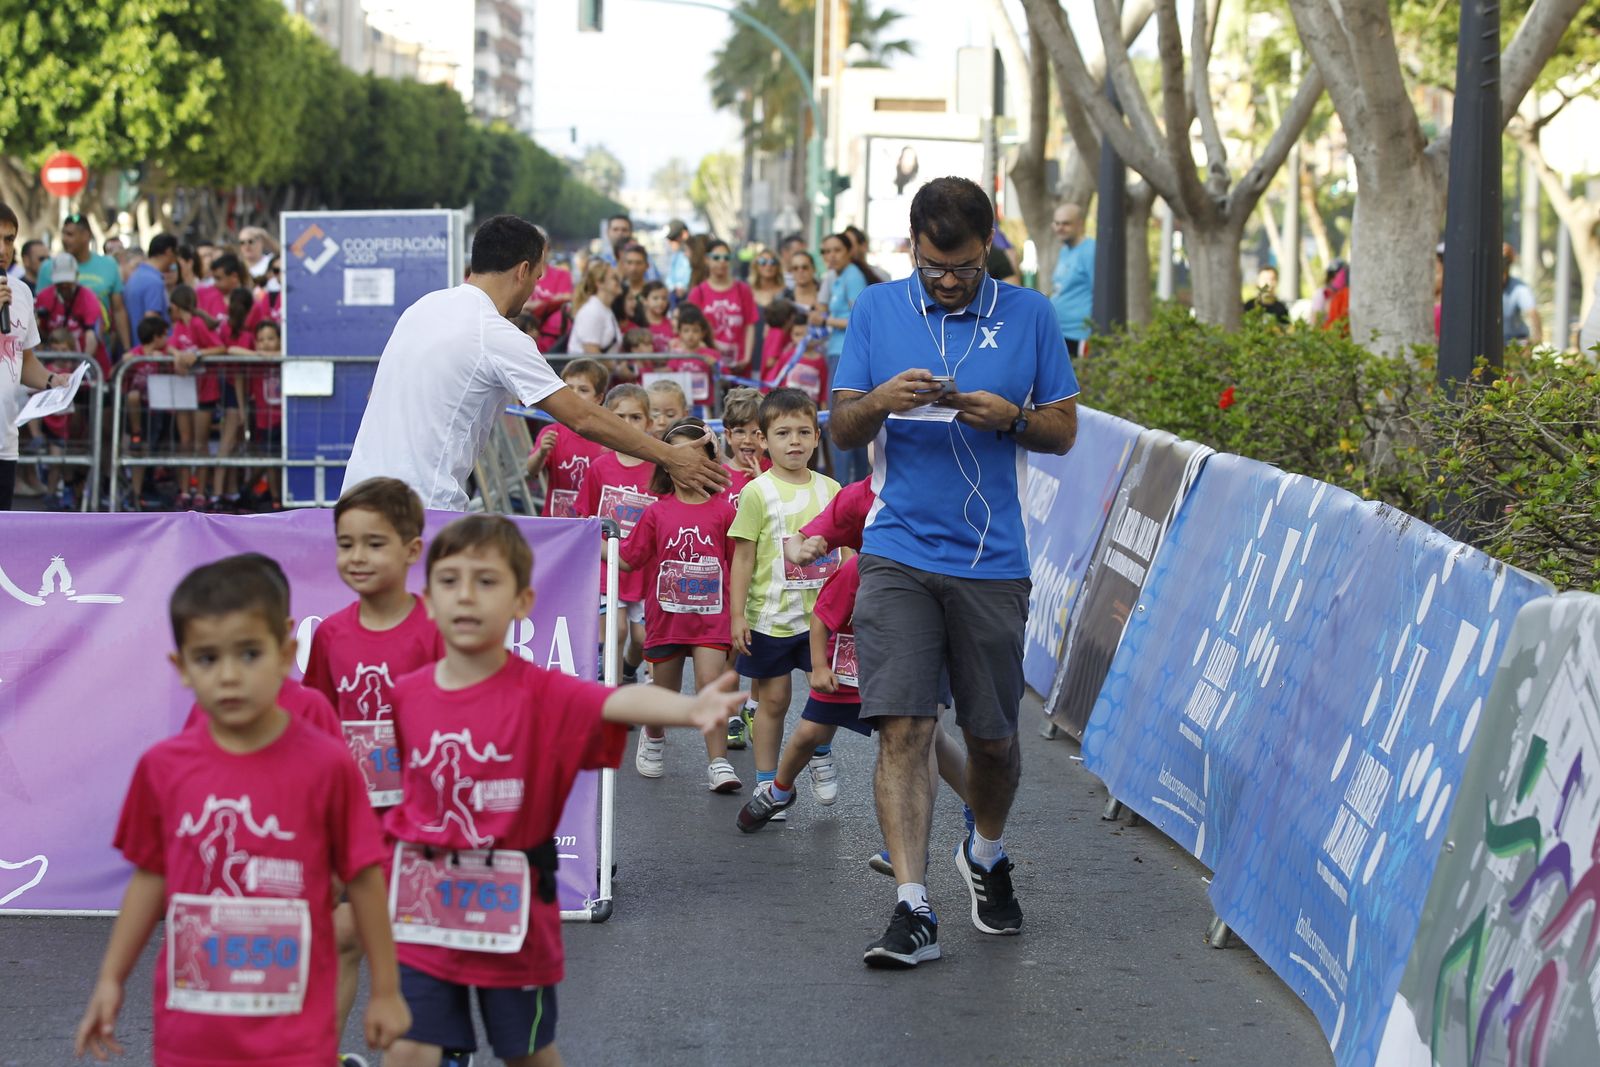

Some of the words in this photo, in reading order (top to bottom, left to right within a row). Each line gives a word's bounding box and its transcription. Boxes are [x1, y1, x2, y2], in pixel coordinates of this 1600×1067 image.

[342, 236, 446, 251] COOPERACIÓN
[678, 577, 720, 594] 1930
[436, 879, 521, 912] 1763
[204, 935, 298, 969] 1550
